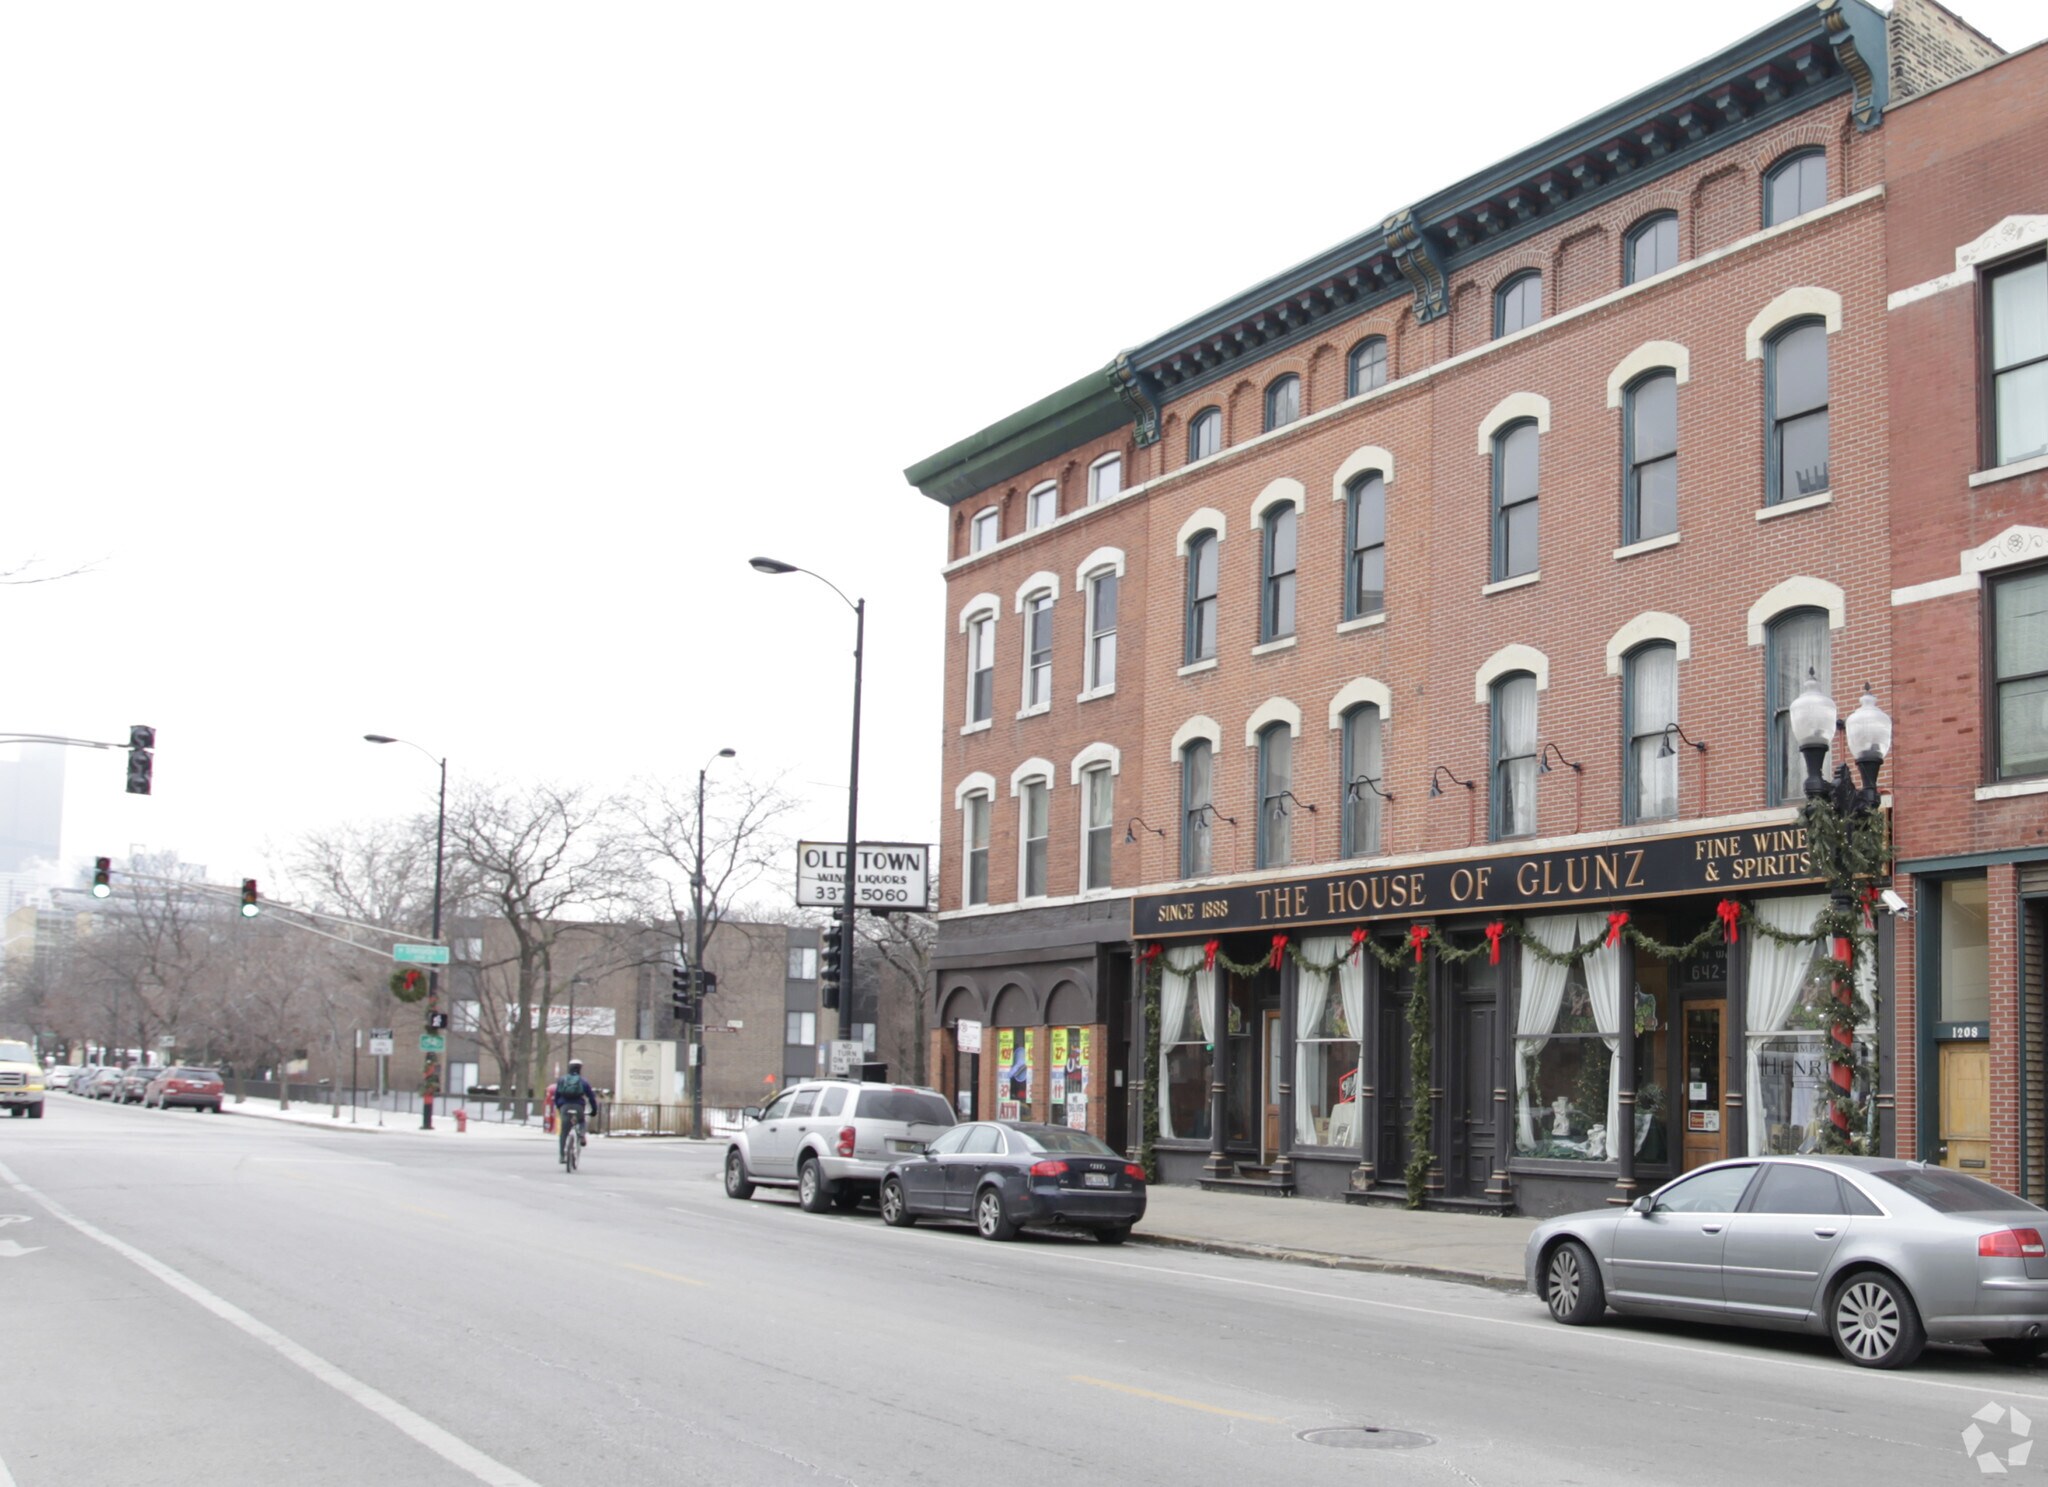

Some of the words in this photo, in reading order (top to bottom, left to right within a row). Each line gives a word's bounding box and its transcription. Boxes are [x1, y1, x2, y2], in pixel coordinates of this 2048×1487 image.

[1695, 836, 1742, 860] FINE
[857, 852, 920, 871] TOWN
[1705, 862, 1720, 881] &
[1732, 852, 1812, 880] SPIRITS
[857, 874, 908, 885] LIQUORS
[1255, 886, 1309, 920] THE
[1327, 873, 1427, 914] HOUSE
[1450, 866, 1492, 901] OF
[1516, 849, 1645, 896] GLUNZ
[1158, 903, 1194, 922] SINCE
[1202, 900, 1229, 919] 1888
[1952, 1026, 1978, 1038] 1208
[842, 1042, 853, 1050] NO
